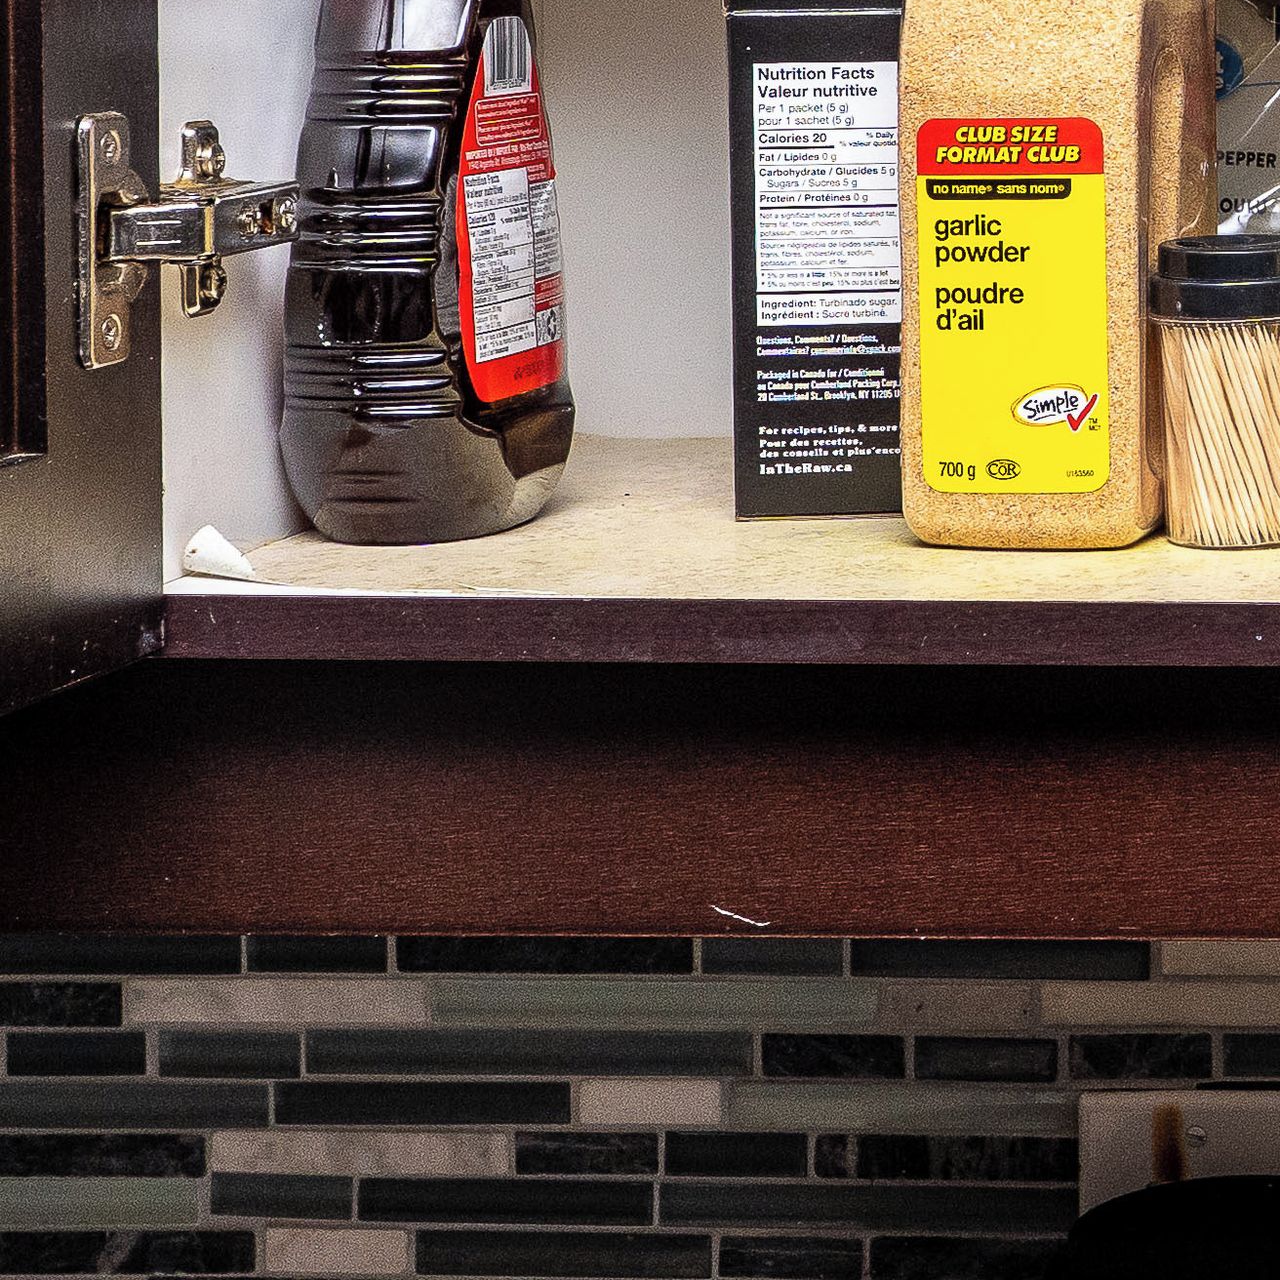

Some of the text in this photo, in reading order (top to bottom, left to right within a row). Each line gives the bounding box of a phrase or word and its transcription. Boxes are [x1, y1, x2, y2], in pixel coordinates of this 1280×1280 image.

[758, 67, 875, 81] Nutrition Facts
[758, 84, 878, 98] Valeur nutritive
[759, 103, 849, 114] Per packet (5 g)
[759, 115, 855, 127] pour sachet (5 g)
[759, 133, 827, 144] Calories 20
[876, 132, 894, 141] Daily
[955, 126, 1058, 143] CLUB SIZE
[760, 153, 774, 161] Fat
[784, 153, 820, 163] Lipides
[936, 146, 1080, 164] FORMAT CLUB
[760, 167, 878, 178] Carbohydrate Glucides
[808, 178, 840, 187] Sucres
[933, 185, 949, 194] no
[996, 185, 1027, 194] sans
[760, 193, 851, 203] Protein Protéines
[934, 215, 1002, 241] garlic
[935, 241, 1030, 266] powder
[936, 282, 1024, 310] poudre
[761, 298, 897, 310] Ingredient: Turbinado sugar.
[936, 309, 984, 331] d'ail
[1023, 391, 1079, 419] Simple
[869, 424, 898, 432] more
[760, 463, 853, 474] InTheRaw.ca
[939, 461, 976, 480] 700 g
